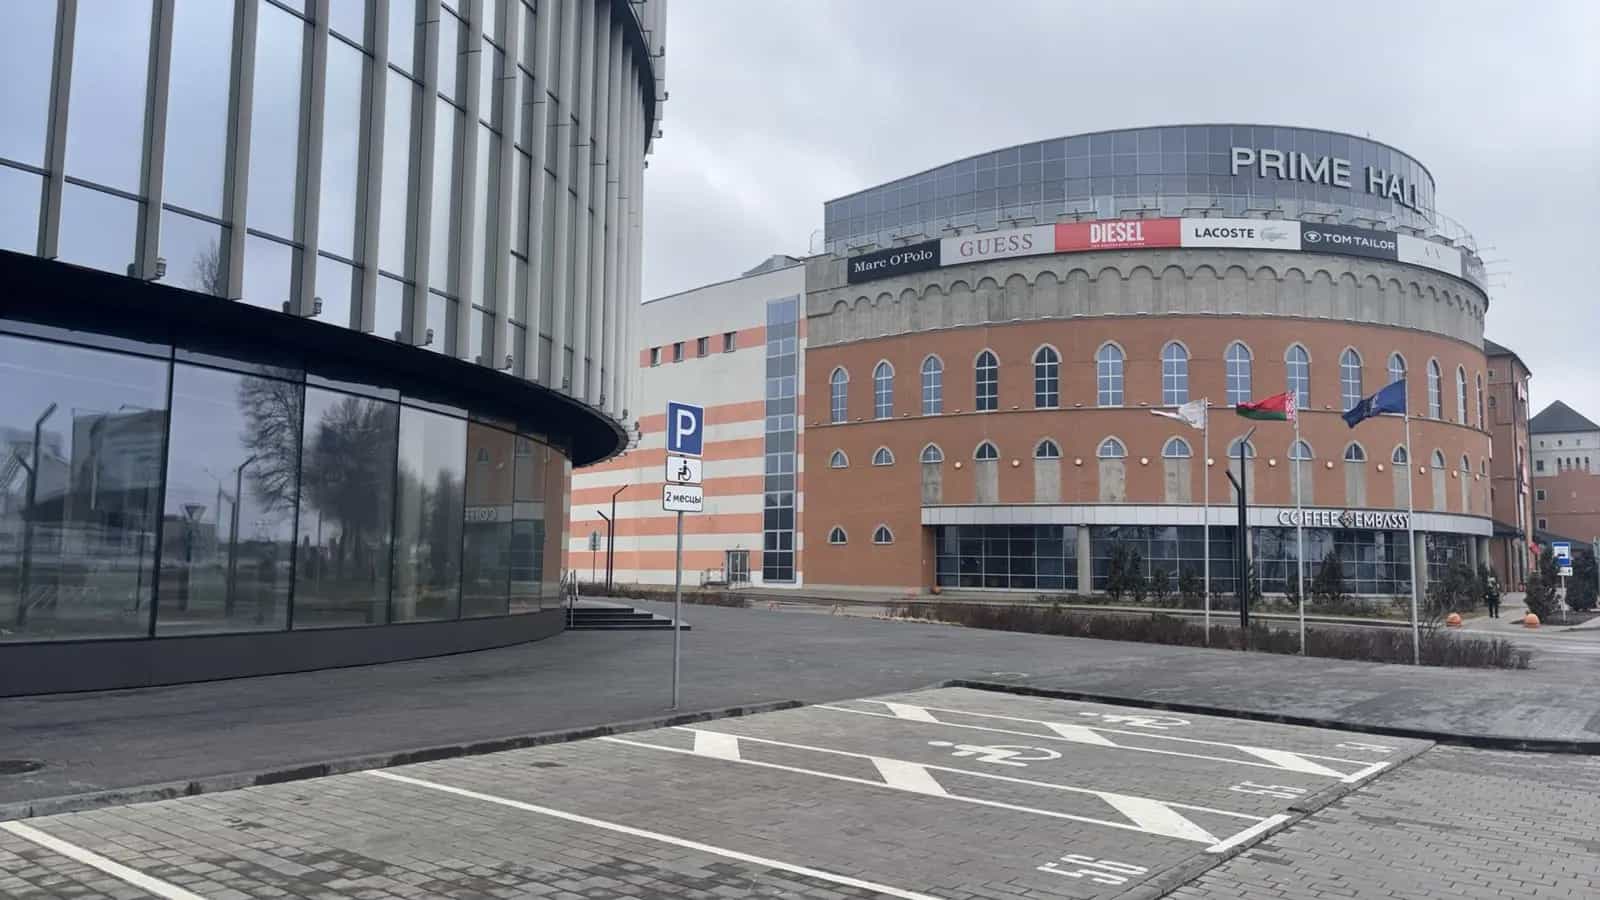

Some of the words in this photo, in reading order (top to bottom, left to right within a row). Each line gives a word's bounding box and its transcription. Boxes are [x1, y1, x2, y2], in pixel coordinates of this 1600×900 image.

[1230, 147, 1352, 188] PRIME
[1366, 164, 1424, 215] HALL
[1090, 221, 1145, 243] DIESEL
[1194, 227, 1255, 238] LACOSTE
[1324, 233, 1351, 244] TOM
[1355, 236, 1395, 250] TAILOR
[960, 233, 1033, 257] GUESS
[854, 258, 887, 272] Marc
[676, 409, 696, 449] P
[666, 491, 672, 502] 2
[672, 495, 702, 504] месцы
[1279, 510, 1339, 526] COFFEE
[1036, 853, 1149, 885] 56
